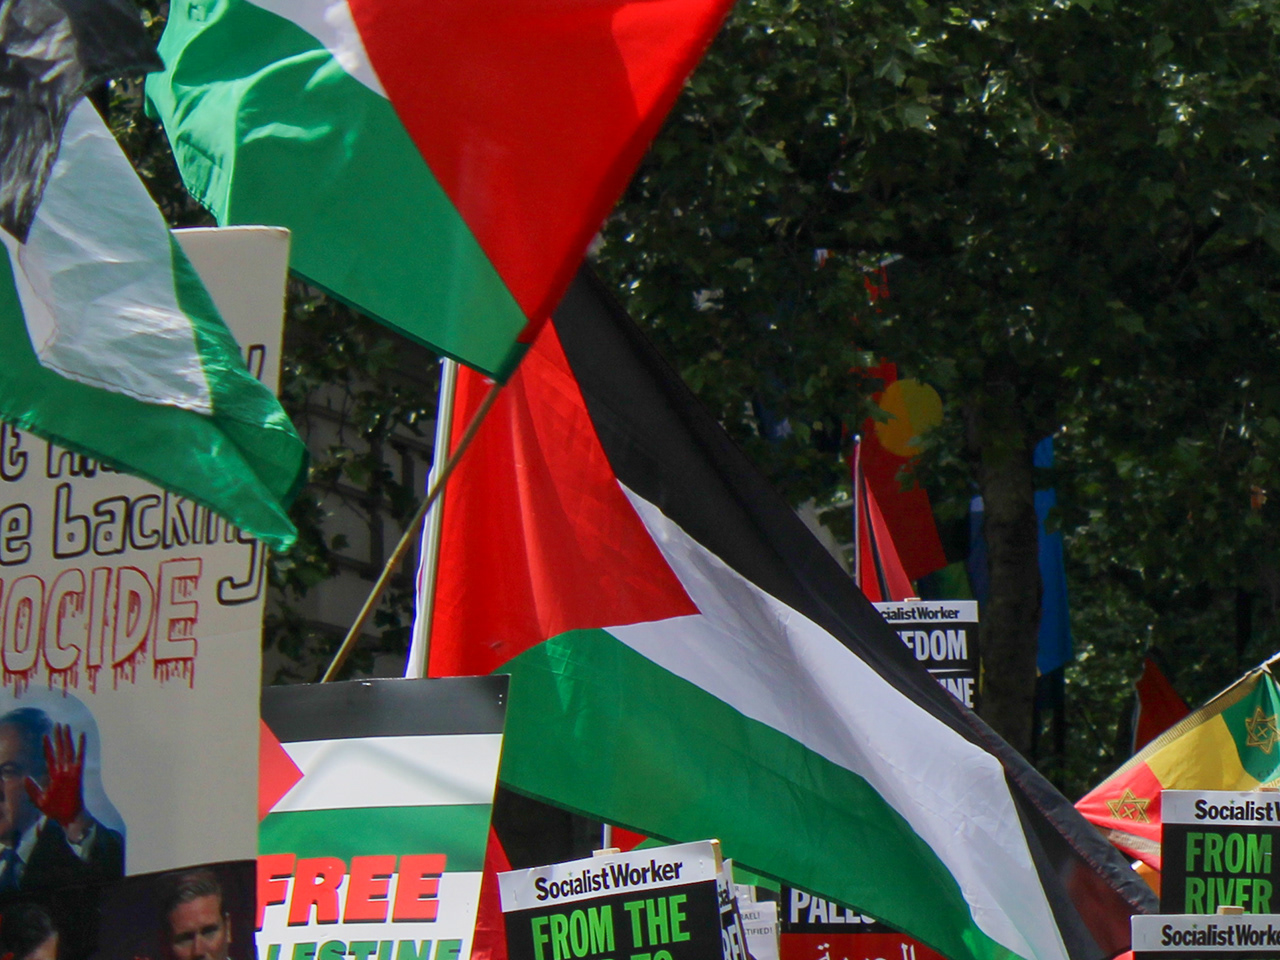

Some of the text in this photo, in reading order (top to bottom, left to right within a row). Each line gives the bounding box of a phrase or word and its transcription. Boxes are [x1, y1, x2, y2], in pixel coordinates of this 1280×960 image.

[0, 557, 203, 688] OCIDE
[1185, 832, 1273, 874] FROM
[256, 853, 448, 933] FREE
[1185, 877, 1273, 915] RIVER
[623, 894, 691, 948] THE
